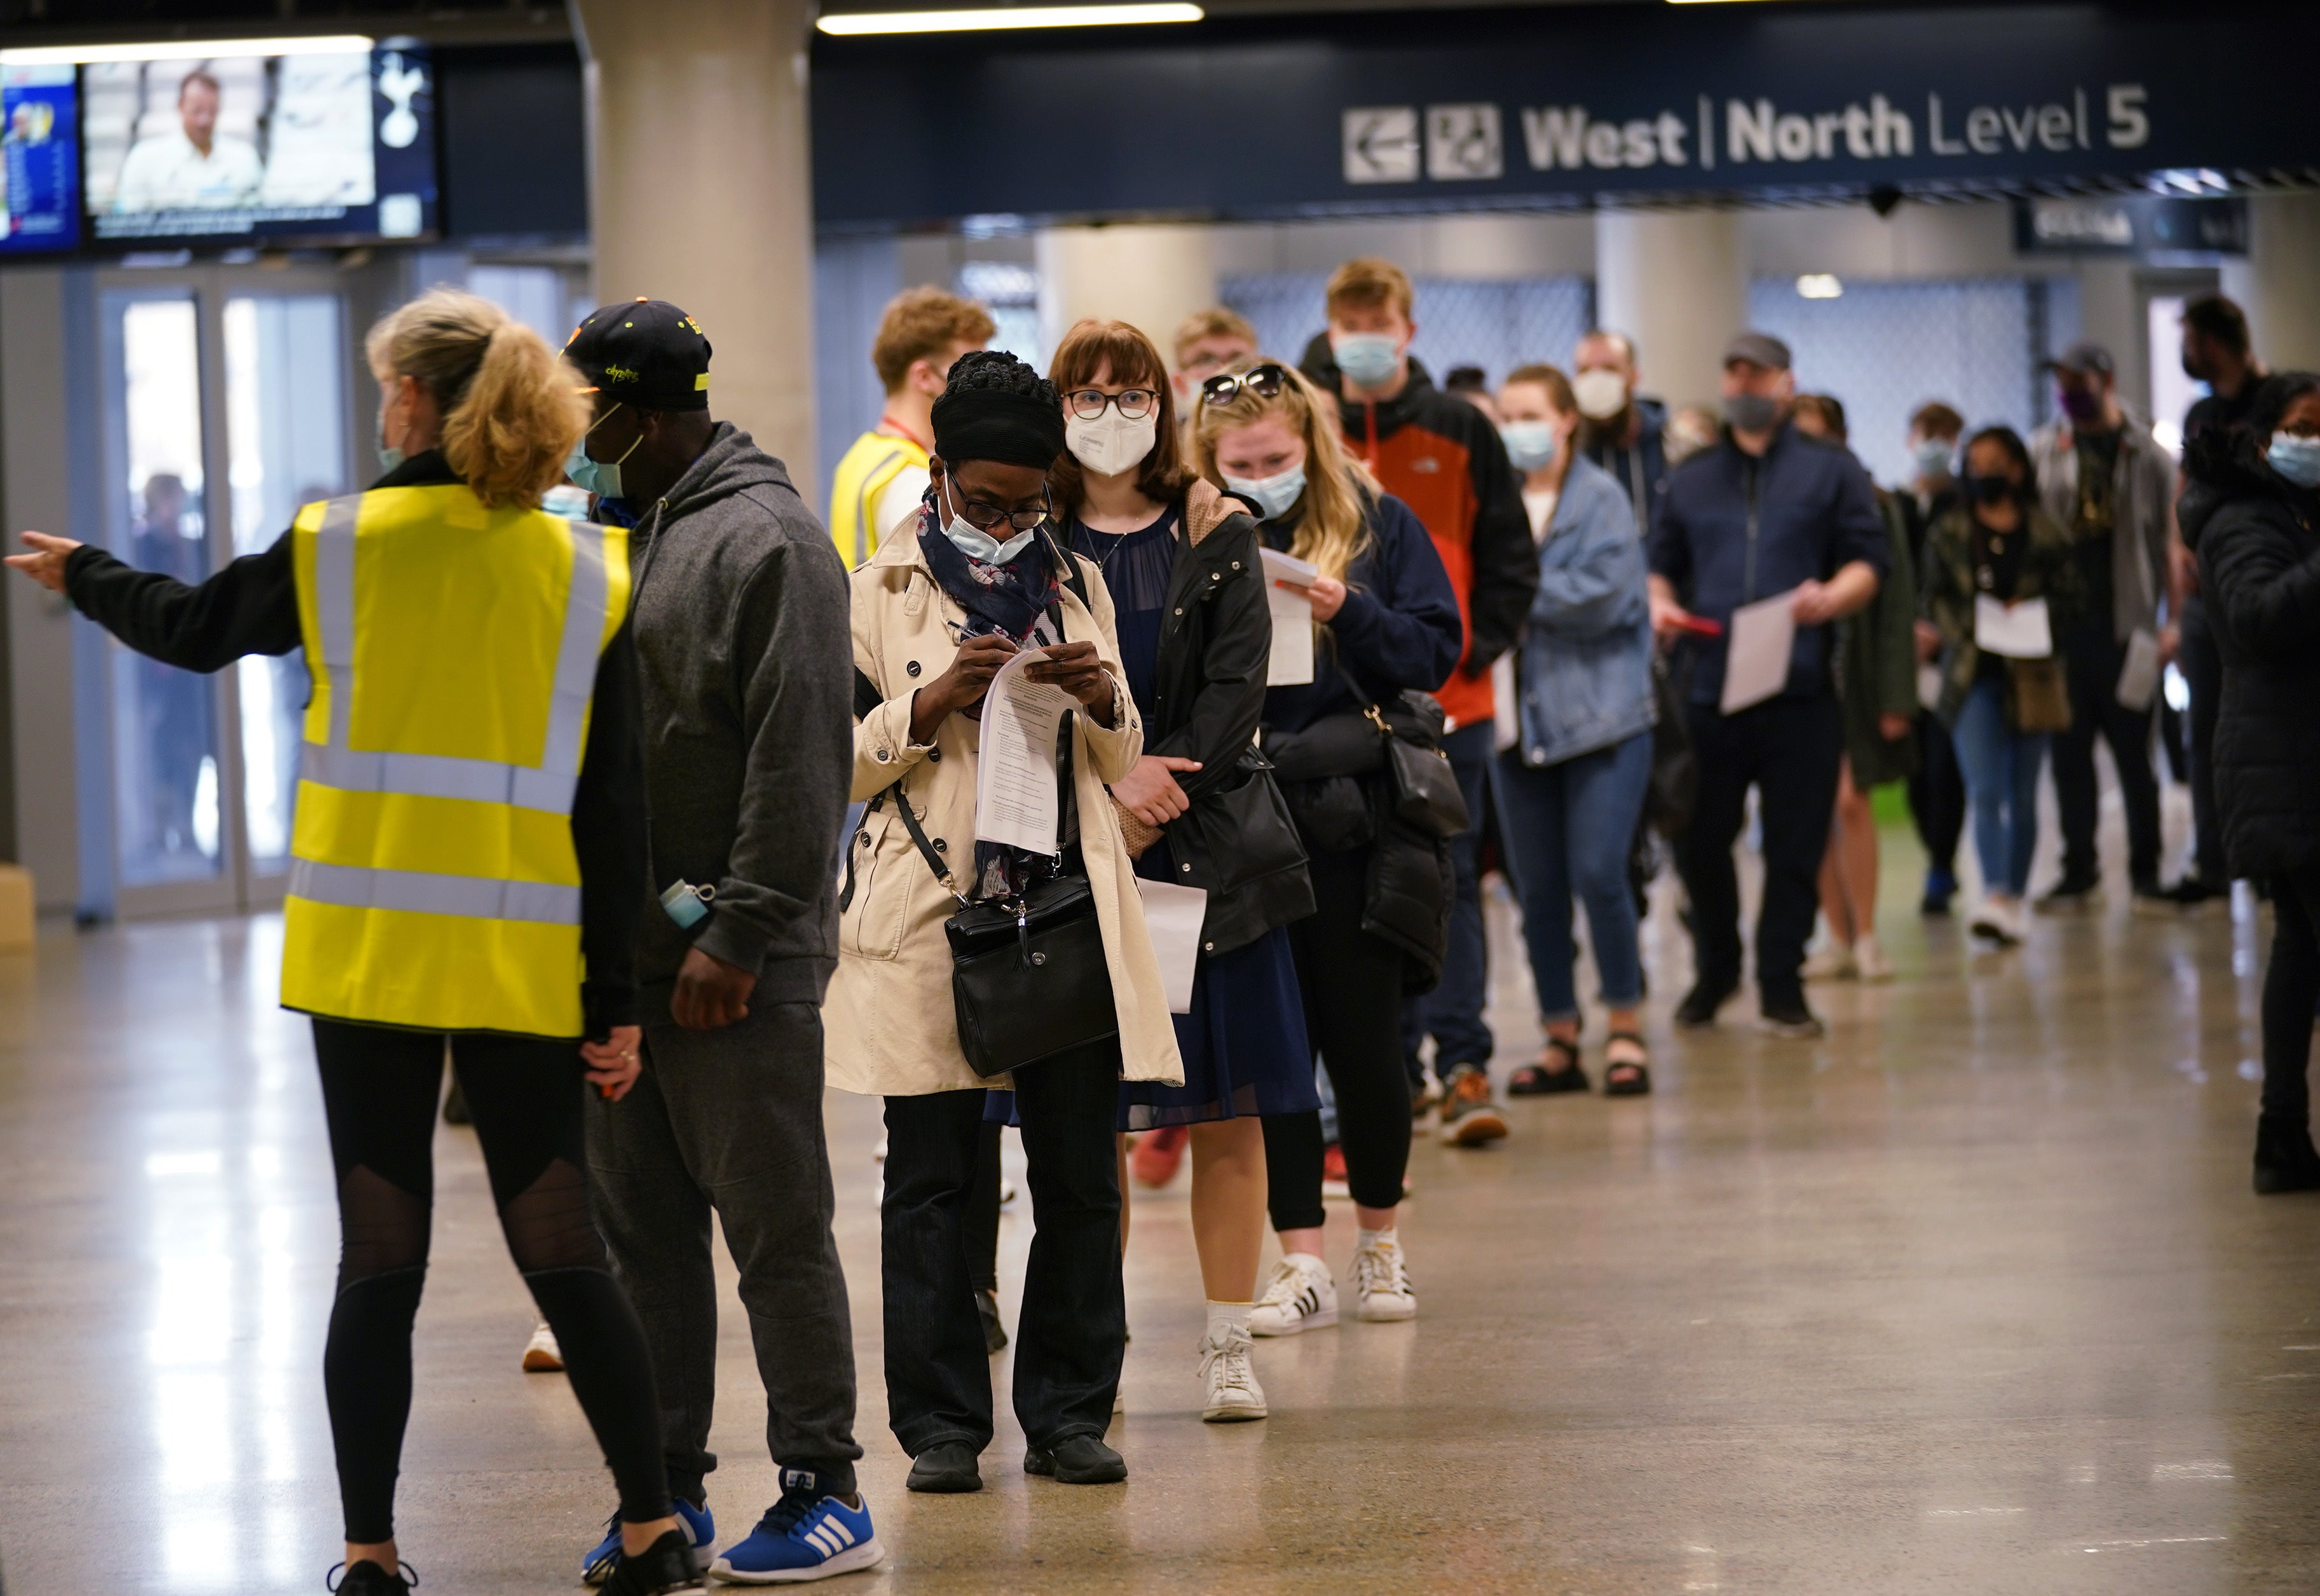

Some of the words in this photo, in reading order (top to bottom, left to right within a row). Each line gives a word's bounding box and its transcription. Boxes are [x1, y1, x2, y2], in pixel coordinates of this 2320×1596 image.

[1522, 106, 1689, 171] West
[1727, 93, 1914, 163] North
[1928, 86, 2091, 156] Level
[2106, 83, 2150, 149] 5
